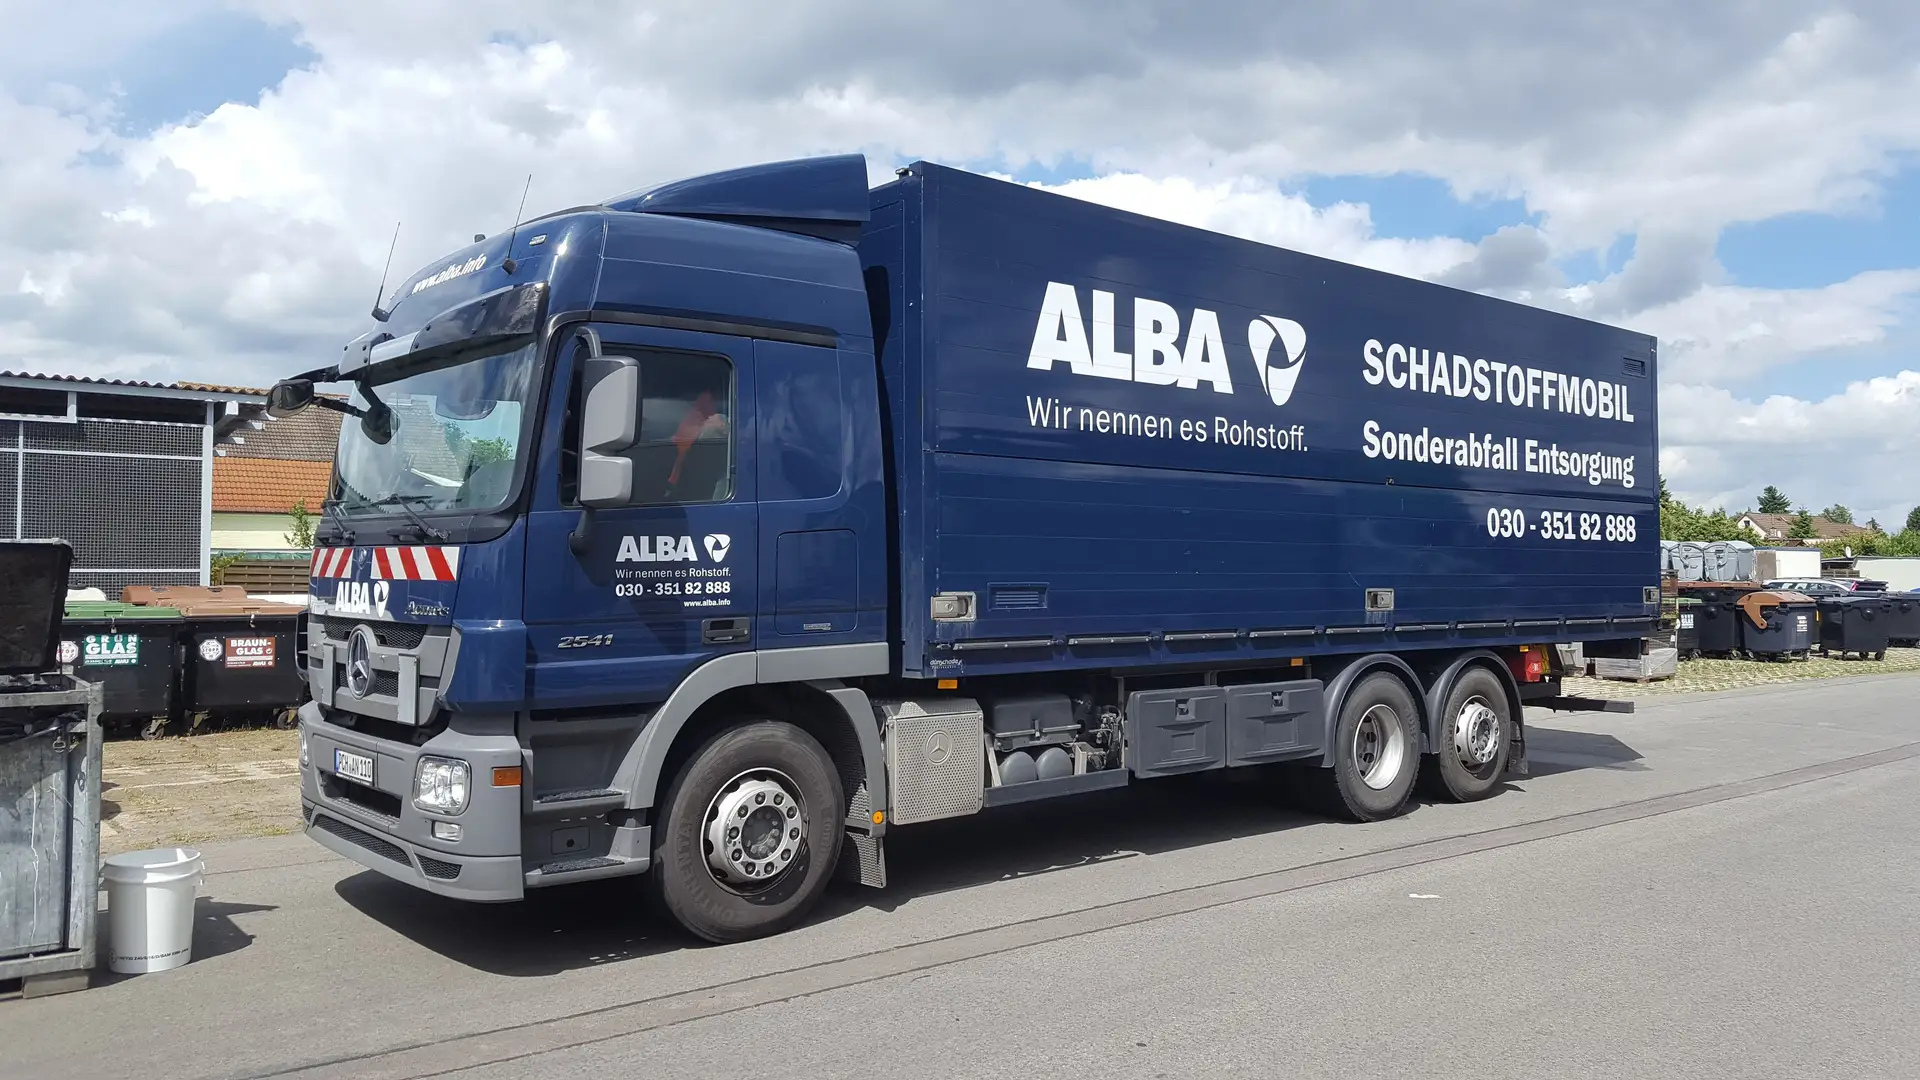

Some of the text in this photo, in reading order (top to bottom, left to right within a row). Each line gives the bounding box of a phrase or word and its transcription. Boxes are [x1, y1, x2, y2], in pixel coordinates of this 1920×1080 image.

[411, 253, 487, 295] www.alba.info
[1027, 281, 1233, 394] ALBA
[1362, 338, 1635, 423] SCHADSTOFFMOBIL
[1026, 395, 1308, 452] Wir nennen es Rohstoff.
[1362, 420, 1635, 489] Sonderabfall Entsorgung
[1487, 507, 1525, 538] 030
[1540, 510, 1576, 540] 351
[1579, 513, 1602, 541] 82
[1605, 514, 1637, 543] 888
[615, 535, 699, 562] ALBA
[615, 567, 731, 579] Wir nennen es Rohstoff.
[335, 580, 371, 615] ALBA
[615, 583, 643, 597] 030
[654, 582, 682, 596] 351
[684, 581, 702, 595] 82
[705, 581, 731, 595] 888
[683, 598, 731, 608] www.alba.info
[85, 642, 137, 655] GLAS
[230, 638, 272, 647] BRAUN-
[235, 647, 264, 656] GLAS
[557, 633, 614, 649] 2541
